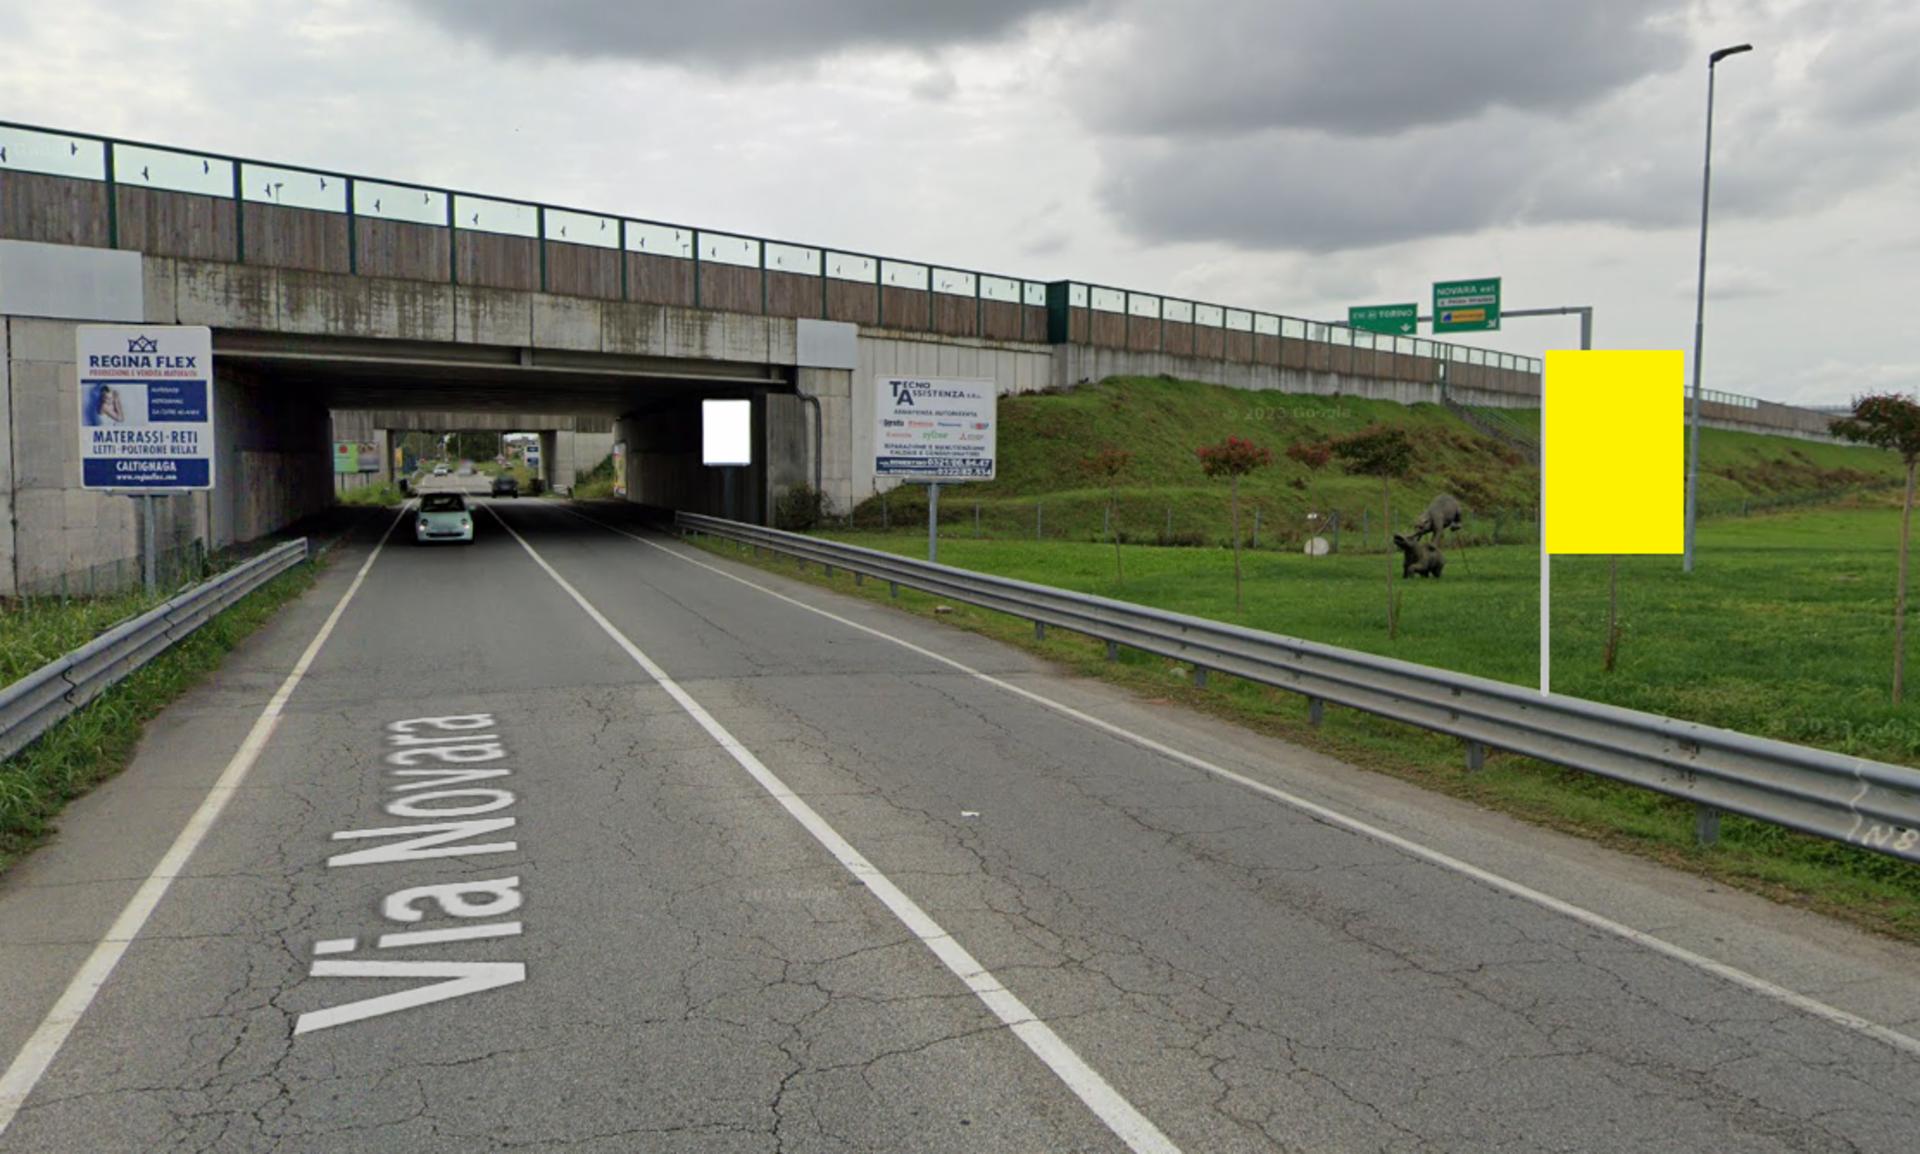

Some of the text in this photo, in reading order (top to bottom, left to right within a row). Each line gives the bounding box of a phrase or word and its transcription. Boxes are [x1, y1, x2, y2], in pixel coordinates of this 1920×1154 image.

[1437, 285, 1477, 295] NOVARA
[1379, 308, 1413, 319] TORINO
[89, 355, 196, 368] REGINA FLEX
[93, 430, 198, 443] MATERASSI RETI
[93, 444, 198, 455] LETTI POLTRONE RELAX
[116, 461, 177, 472] CALTIGNAGA
